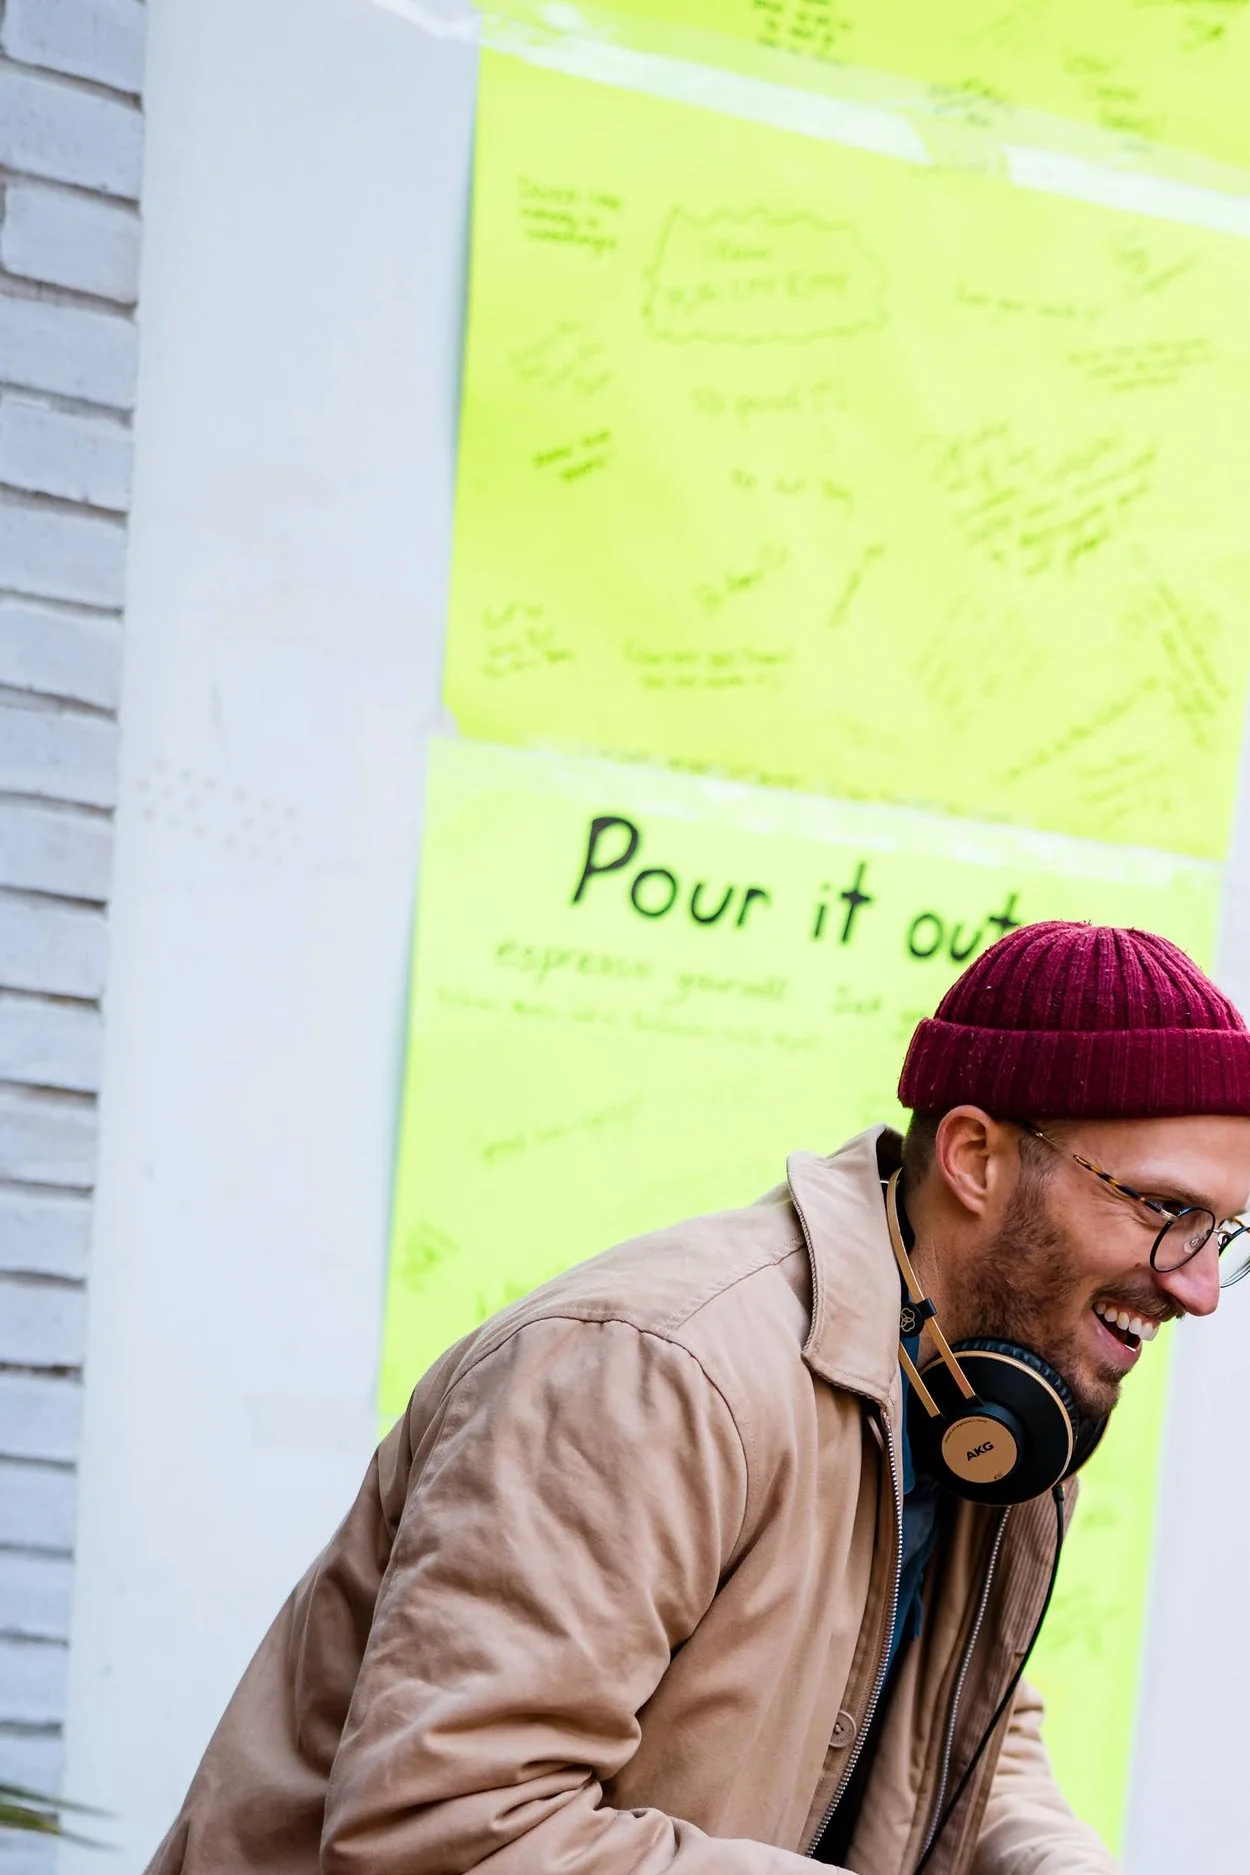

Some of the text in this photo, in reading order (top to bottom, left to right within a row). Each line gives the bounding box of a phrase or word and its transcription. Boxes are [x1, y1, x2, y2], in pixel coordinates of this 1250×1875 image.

[570, 816, 770, 928] Pour
[811, 861, 873, 944] it
[966, 1441, 995, 1462] AKG
